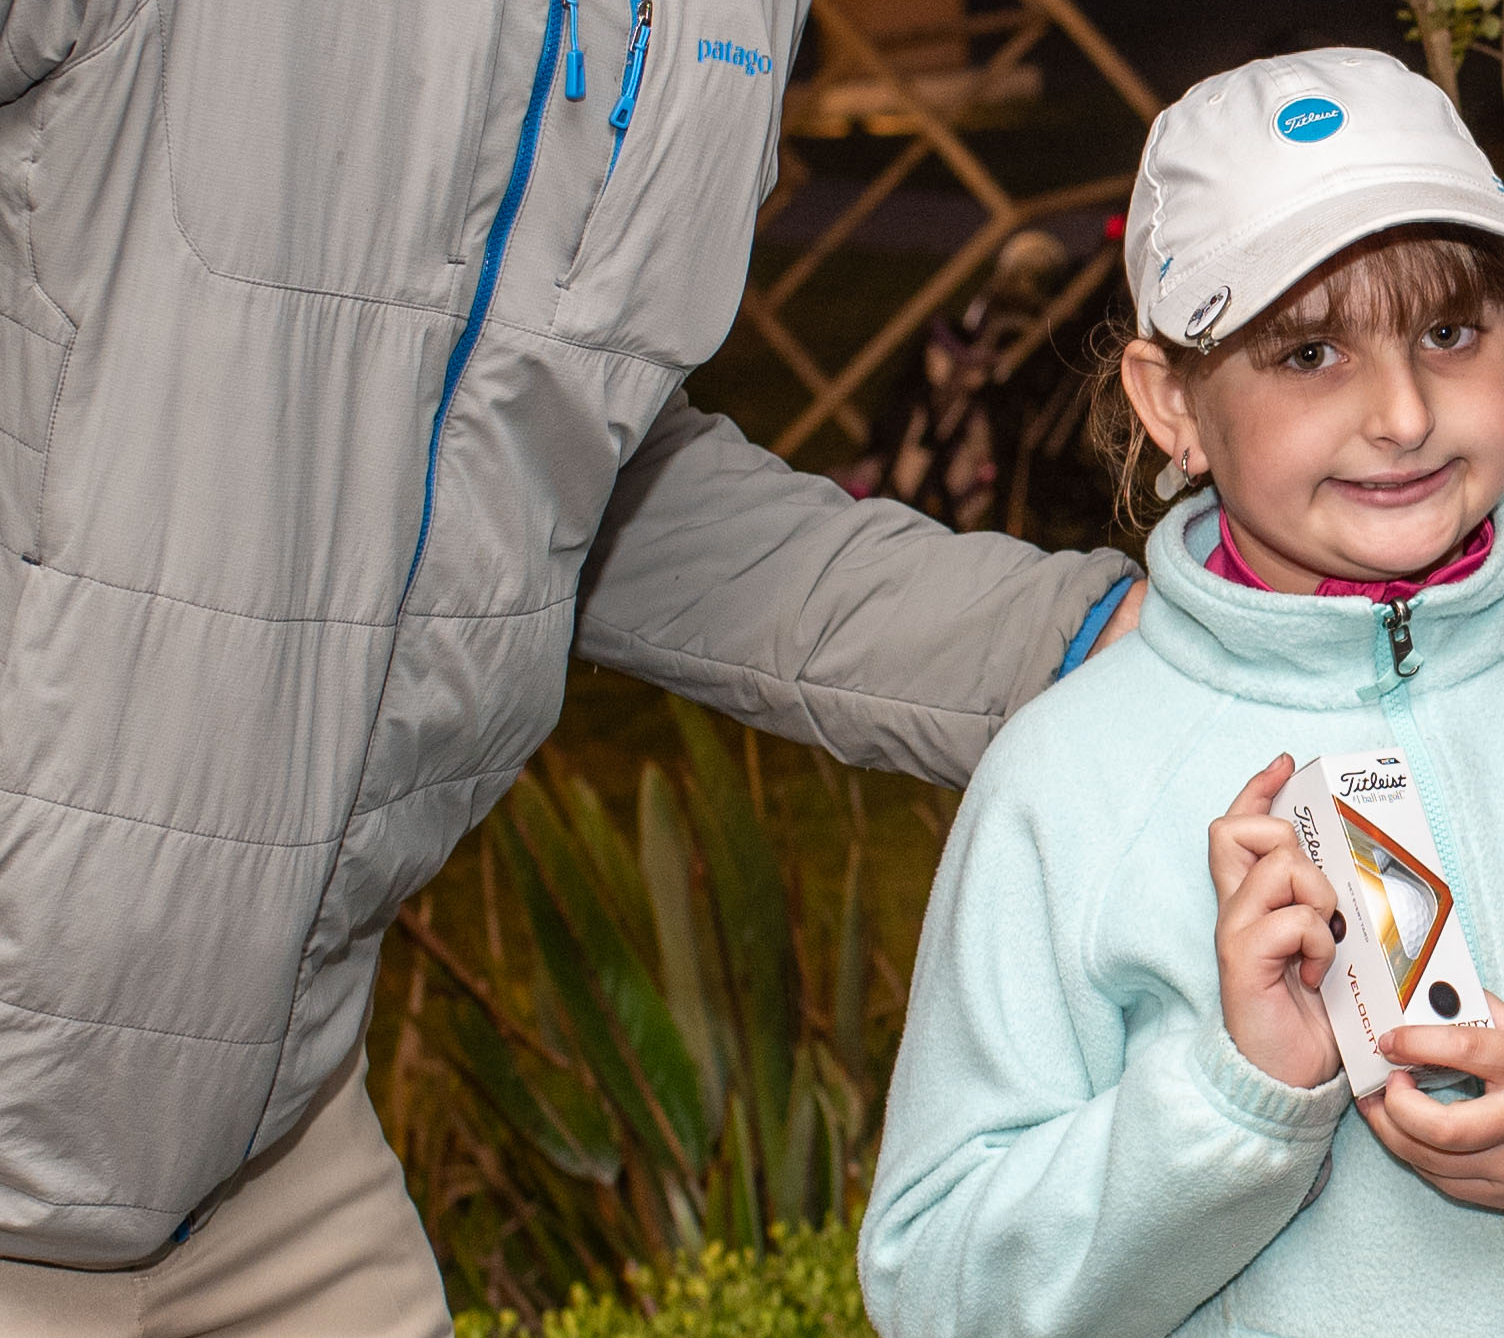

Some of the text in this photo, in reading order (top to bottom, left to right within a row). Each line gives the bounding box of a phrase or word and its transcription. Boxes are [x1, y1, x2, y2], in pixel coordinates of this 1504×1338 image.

[1284, 107, 1339, 133] Titleist
[1340, 770, 1406, 796] Titleist
[1362, 792, 1377, 802] ball
[1378, 792, 1386, 801] in
[1347, 964, 1381, 1056] VELOCITY
